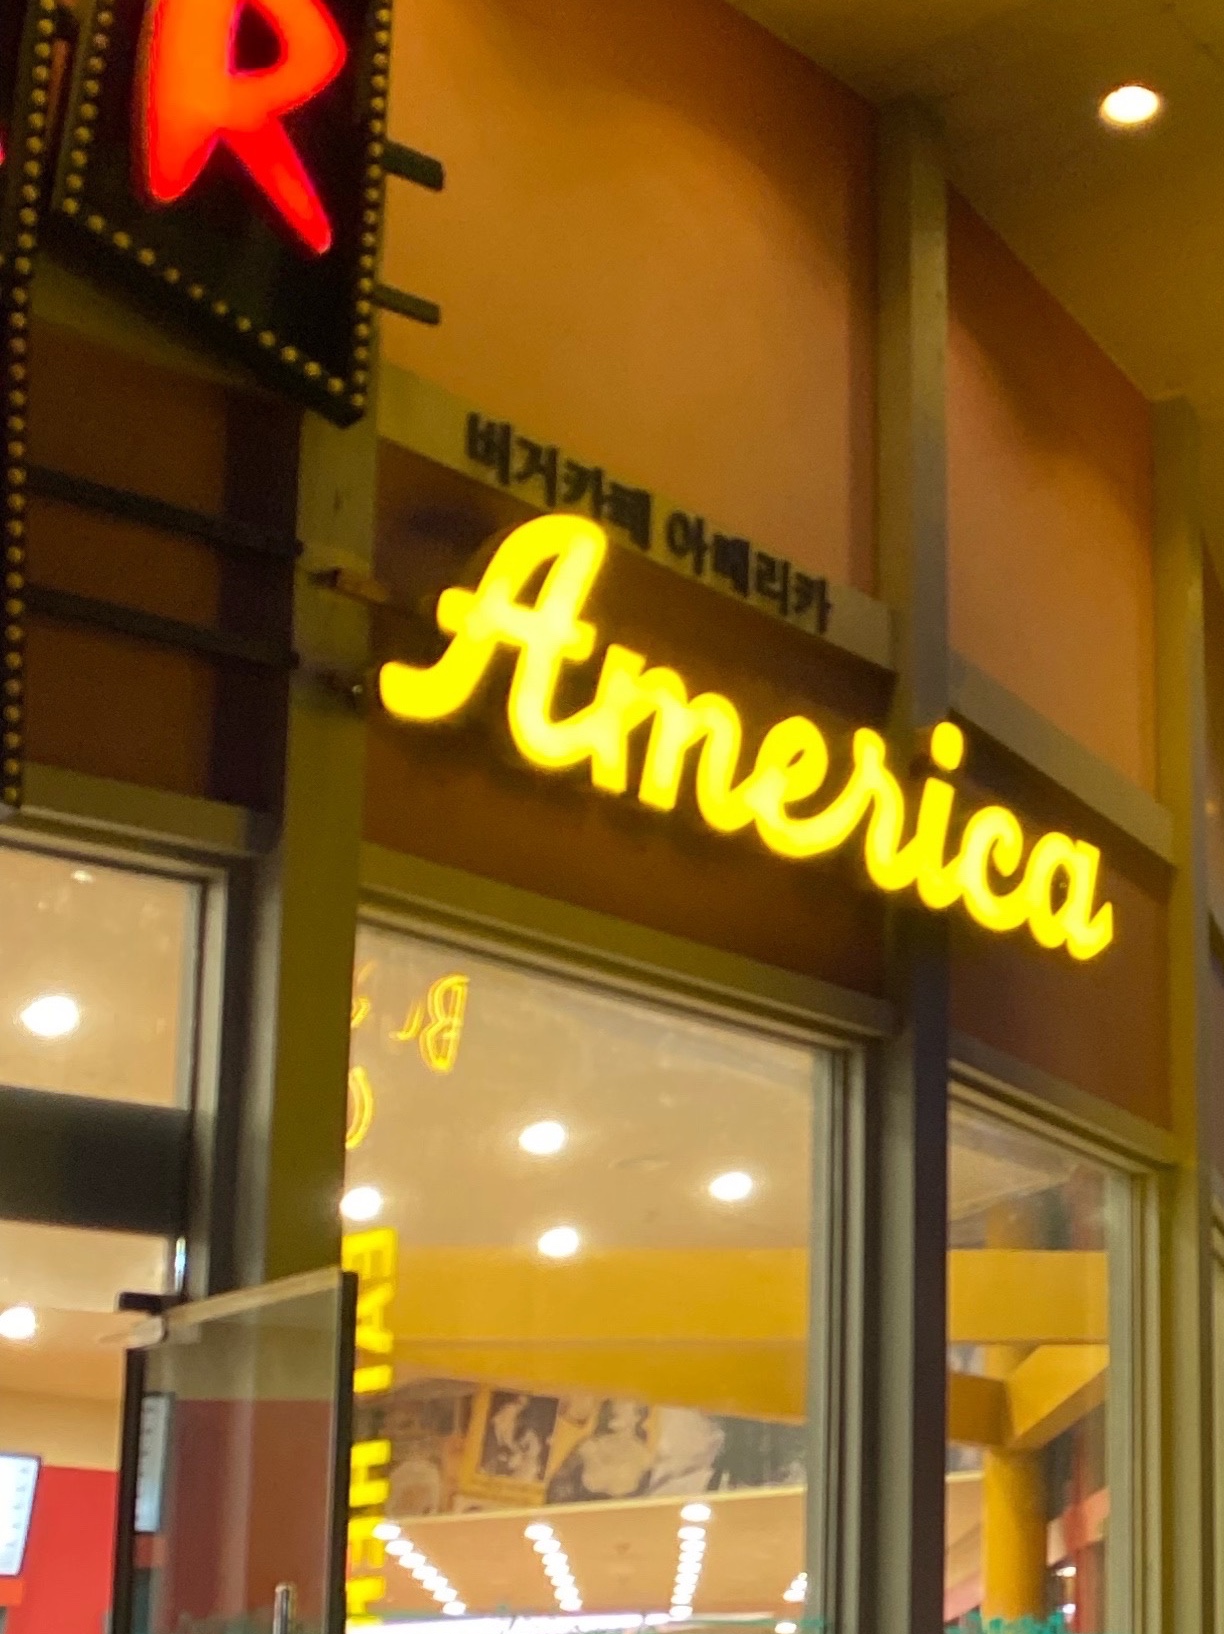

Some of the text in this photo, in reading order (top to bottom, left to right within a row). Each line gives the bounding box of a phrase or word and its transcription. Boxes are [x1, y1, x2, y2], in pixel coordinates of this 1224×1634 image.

[464, 410, 832, 636] 버거카페 아메리카
[379, 513, 1114, 962] America
